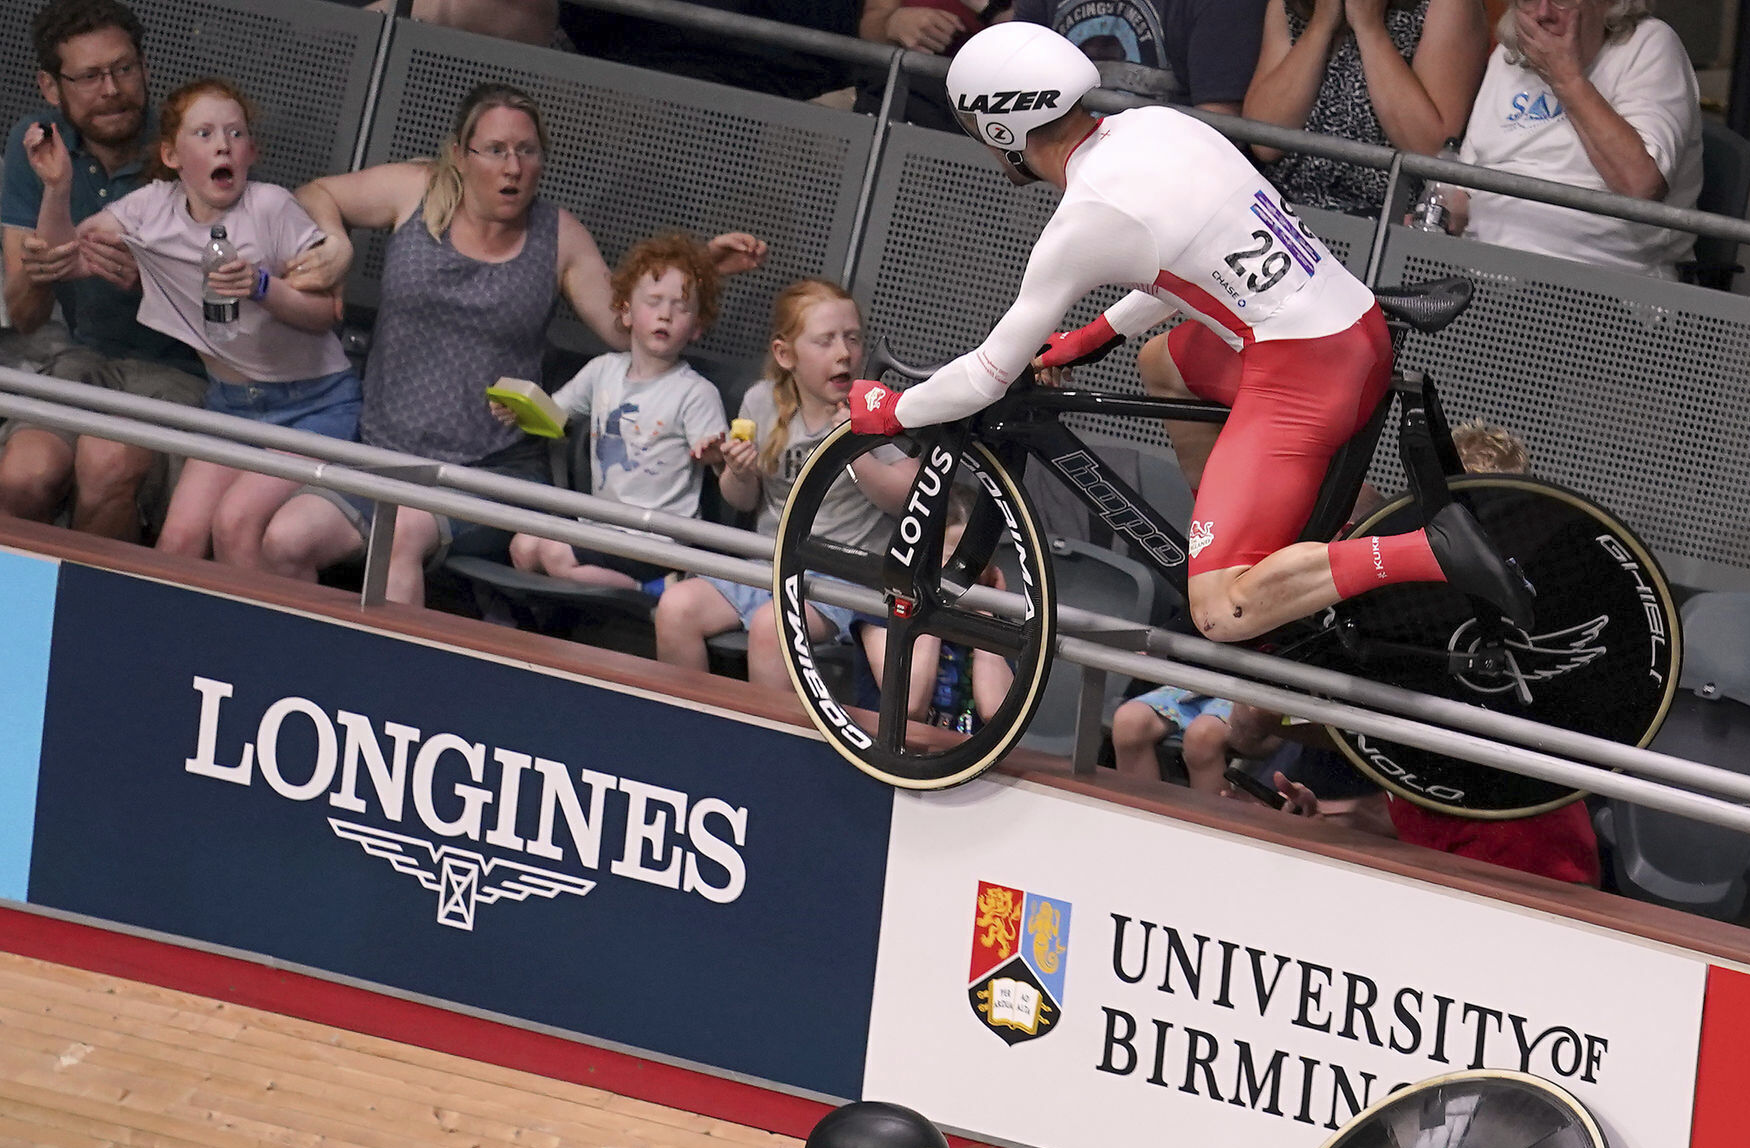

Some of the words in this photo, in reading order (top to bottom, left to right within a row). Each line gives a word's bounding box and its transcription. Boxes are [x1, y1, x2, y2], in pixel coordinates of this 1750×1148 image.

[957, 89, 1061, 115] LAZER
[1211, 270, 1240, 300] CHASE
[1223, 229, 1292, 293] 29
[890, 445, 954, 568] LOTUS
[959, 450, 1036, 623] CORIMA
[1052, 449, 1186, 567] hope
[1372, 536, 1384, 570] KUKR
[785, 574, 873, 751] CORIMA
[184, 674, 749, 904] LONGINES
[1109, 911, 1562, 1074] UNIVERSITY
[1550, 1024, 1609, 1085] OF
[1095, 1005, 1414, 1132] BIRMIN
